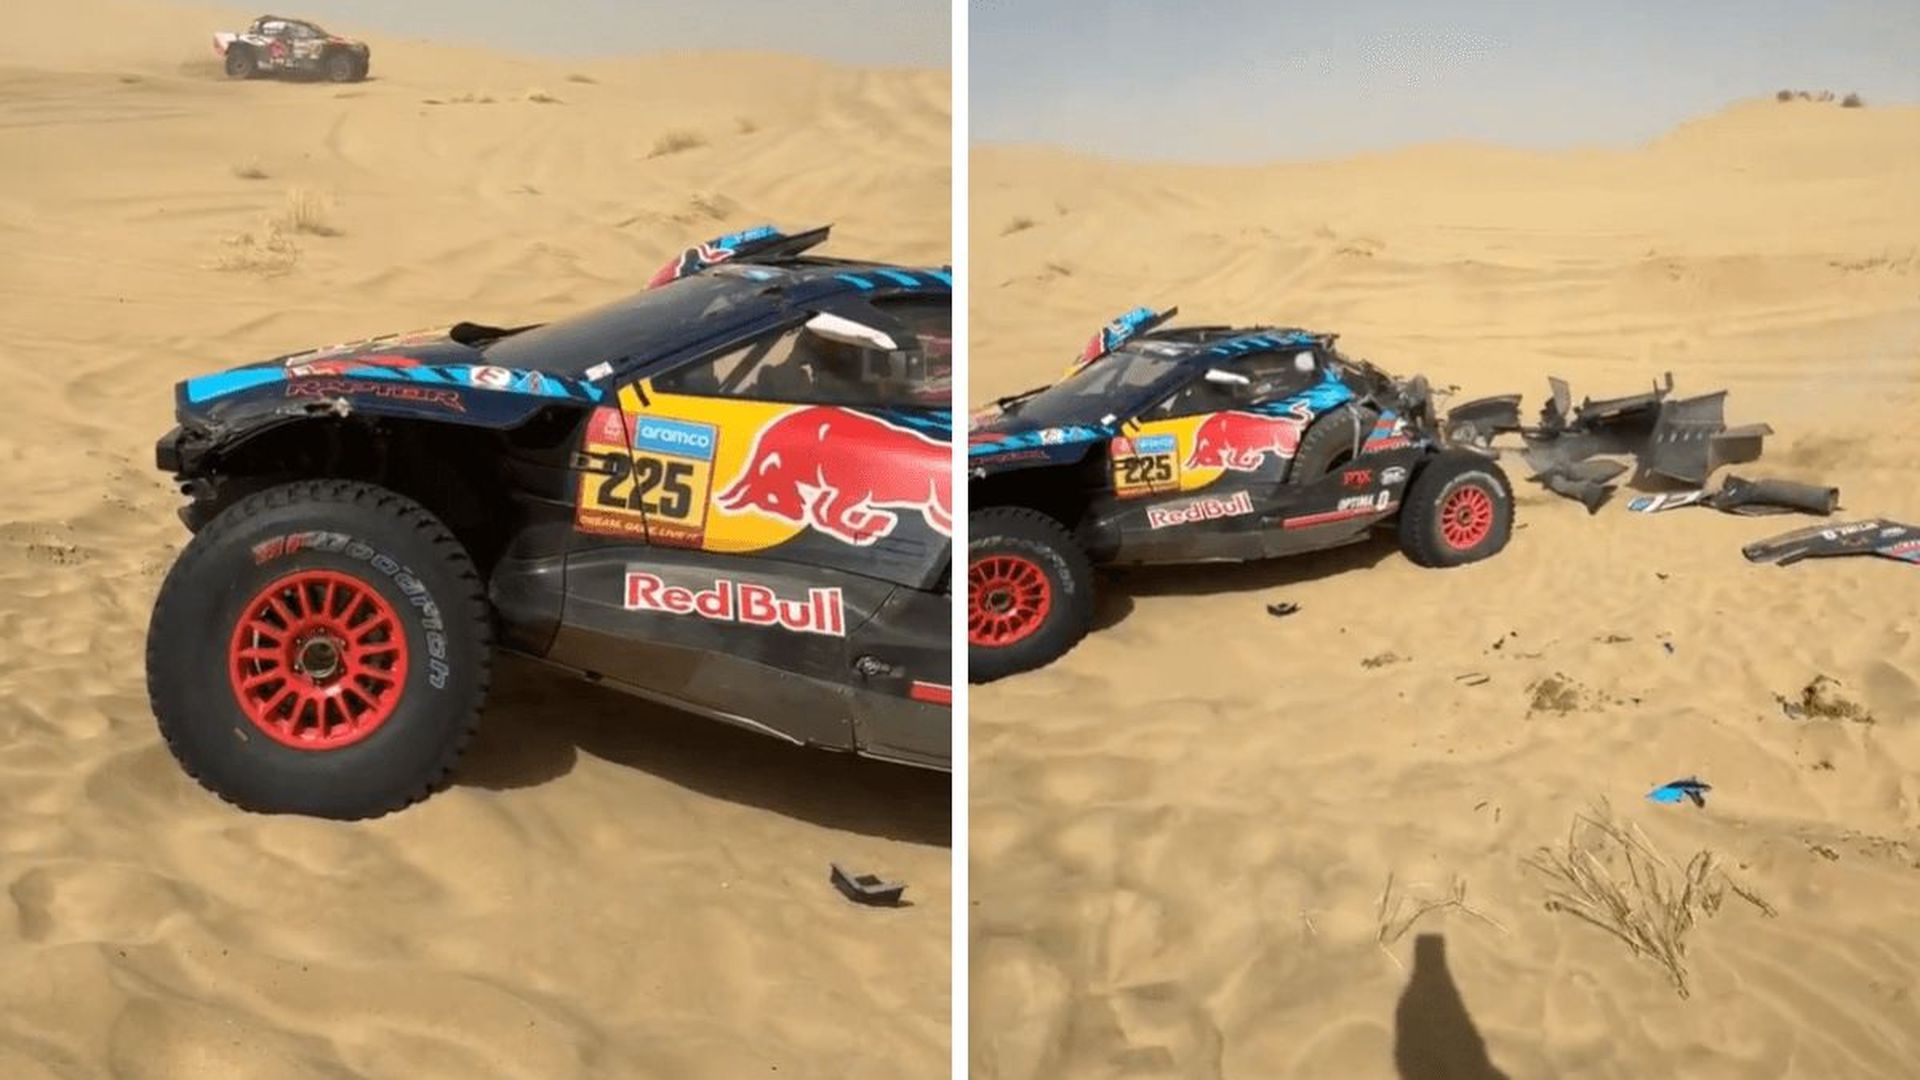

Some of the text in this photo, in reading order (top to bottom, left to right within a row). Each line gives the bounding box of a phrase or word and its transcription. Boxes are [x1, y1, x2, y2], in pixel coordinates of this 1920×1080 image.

[641, 426, 709, 448] aramco
[597, 452, 694, 519] 225
[1125, 455, 1172, 484] 225
[1148, 502, 1204, 529] Red
[1202, 491, 1253, 518] Bull
[625, 573, 845, 637] Red Bull
